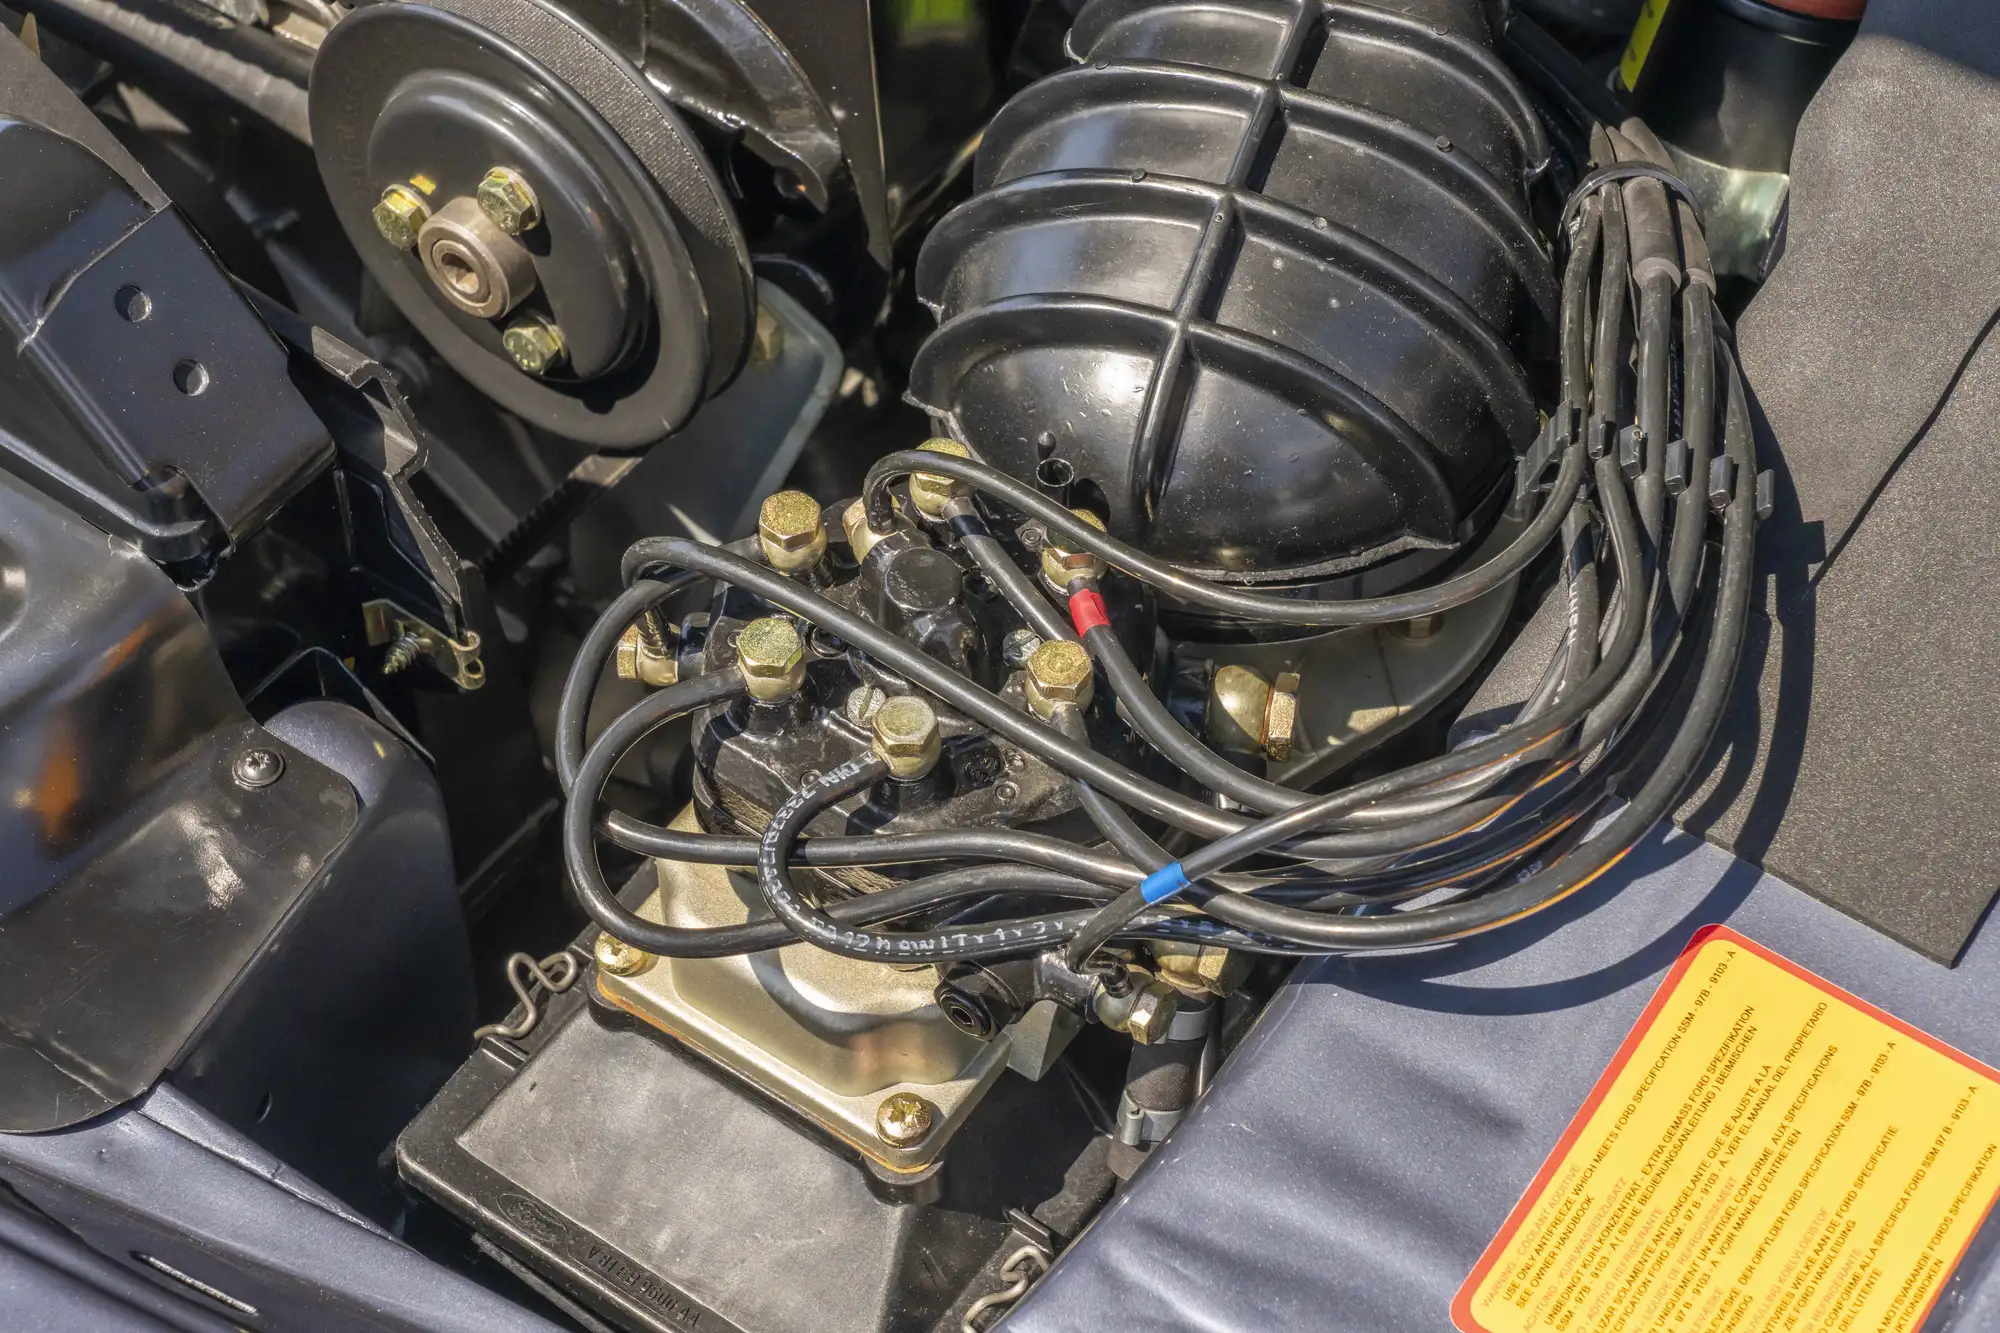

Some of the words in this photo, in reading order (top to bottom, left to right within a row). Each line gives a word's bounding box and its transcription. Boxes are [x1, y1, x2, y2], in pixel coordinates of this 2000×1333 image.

[1502, 1279, 1521, 1302] USE
[1516, 1254, 1538, 1281] ONLY
[1532, 1195, 1576, 1256] ANTIFREEZE
[1570, 1162, 1597, 1197] WHICH
[1592, 1129, 1619, 1164] MEETS
[1613, 1102, 1637, 1131] FORD
[1631, 1032, 1682, 1103] SPECIFICATION
[1676, 1011, 1696, 1034] SSM
[1693, 987, 1710, 1007] 97B
[1708, 961, 1728, 984] 9103
[1725, 948, 1736, 958] A
[1728, 1084, 1758, 1123] AJUSTE
[1752, 1075, 1763, 1086] A
[1757, 1062, 1772, 1078] LA
[1555, 1308, 1575, 1332] SSM
[1573, 1284, 1591, 1304] 97B
[1589, 1254, 1610, 1279] 9103
[1608, 1240, 1619, 1250] A
[1617, 1205, 1641, 1236] SIEHE
[1714, 1025, 1758, 1085] BEIMISCHEN
[1609, 1276, 1652, 1333] CIFICATION
[1646, 1247, 1671, 1278] FORD
[1665, 1225, 1685, 1249] SSM
[1683, 1208, 1696, 1221] 97
[1691, 1199, 1702, 1209] B
[1700, 1171, 1720, 1195] 9103
[1724, 1134, 1743, 1157] VER
[1738, 1120, 1751, 1135] EL
[1746, 1081, 1777, 1122] MANUAL
[1771, 1062, 1789, 1083] DEL
[1783, 1000, 1828, 1064] PROPIETARIO
[1653, 1260, 1702, 1328] UNIQUEMENT
[1696, 1244, 1712, 1262] UN
[1705, 1202, 1738, 1246] ANTIGEL
[1732, 1145, 1774, 1204] CONFORME
[1769, 1121, 1789, 1145] AUX
[1782, 1043, 1839, 1123] SPECIFICATIONS
[1705, 1135, 1726, 1160] QUE
[1719, 1121, 1734, 1137] SE
[1736, 1263, 1756, 1286] DER
[1749, 1214, 1787, 1265] OPFYLDER
[1780, 1187, 1804, 1216] FORD
[1839, 1100, 1859, 1122] SSM
[1856, 1078, 1872, 1097] 97B
[1869, 1052, 1889, 1075] 9103
[1886, 1039, 1896, 1050] A
[1515, 1287, 1534, 1309] SEE
[1528, 1249, 1558, 1288] OWNER
[1552, 1193, 1594, 1251] HANDBOOK
[1543, 1269, 1585, 1326] UNBEDINGT
[1640, 1142, 1667, 1176] EXTRA
[1661, 1101, 1693, 1144] GEMASS
[1687, 1073, 1711, 1103] FORD
[1650, 1158, 1711, 1246] ANTICONGELANTE
[1673, 1309, 1687, 1323] 97
[1682, 1300, 1693, 1310] B
[1691, 1271, 1711, 1296] 9103
[1709, 1257, 1720, 1267] A
[1715, 1231, 1737, 1257] VOIR
[1731, 1190, 1763, 1232] MANUEL
[1756, 1127, 1802, 1192] D'ENTRETIEN
[1789, 1255, 1818, 1291] WELKE
[1811, 1233, 1831, 1256] AAN
[1825, 1217, 1841, 1235] DE
[1834, 1189, 1859, 1219] FORD
[1851, 1124, 1899, 1190] SPECIFICATIE
[1821, 1270, 1864, 1328] CONFORME
[1856, 1244, 1879, 1272] ALLA
[1871, 1195, 1910, 1247] SPECIFICA
[1903, 1167, 1927, 1197] FORD
[1920, 1145, 1940, 1169] SSM
[1934, 1133, 1948, 1147] 97
[1942, 1124, 1953, 1134] B
[1950, 1097, 1970, 1121] 9103
[1967, 1083, 1978, 1094] A
[1611, 1243, 1656, 1305] SOLAMENTE
[1781, 1312, 1799, 1331] ZIE
[1791, 1283, 1816, 1314] FORD
[1809, 1218, 1858, 1286] HANDLEIDING
[1878, 1252, 1932, 1327] MOTSVARANDE
[1925, 1214, 1955, 1252] FORDS
